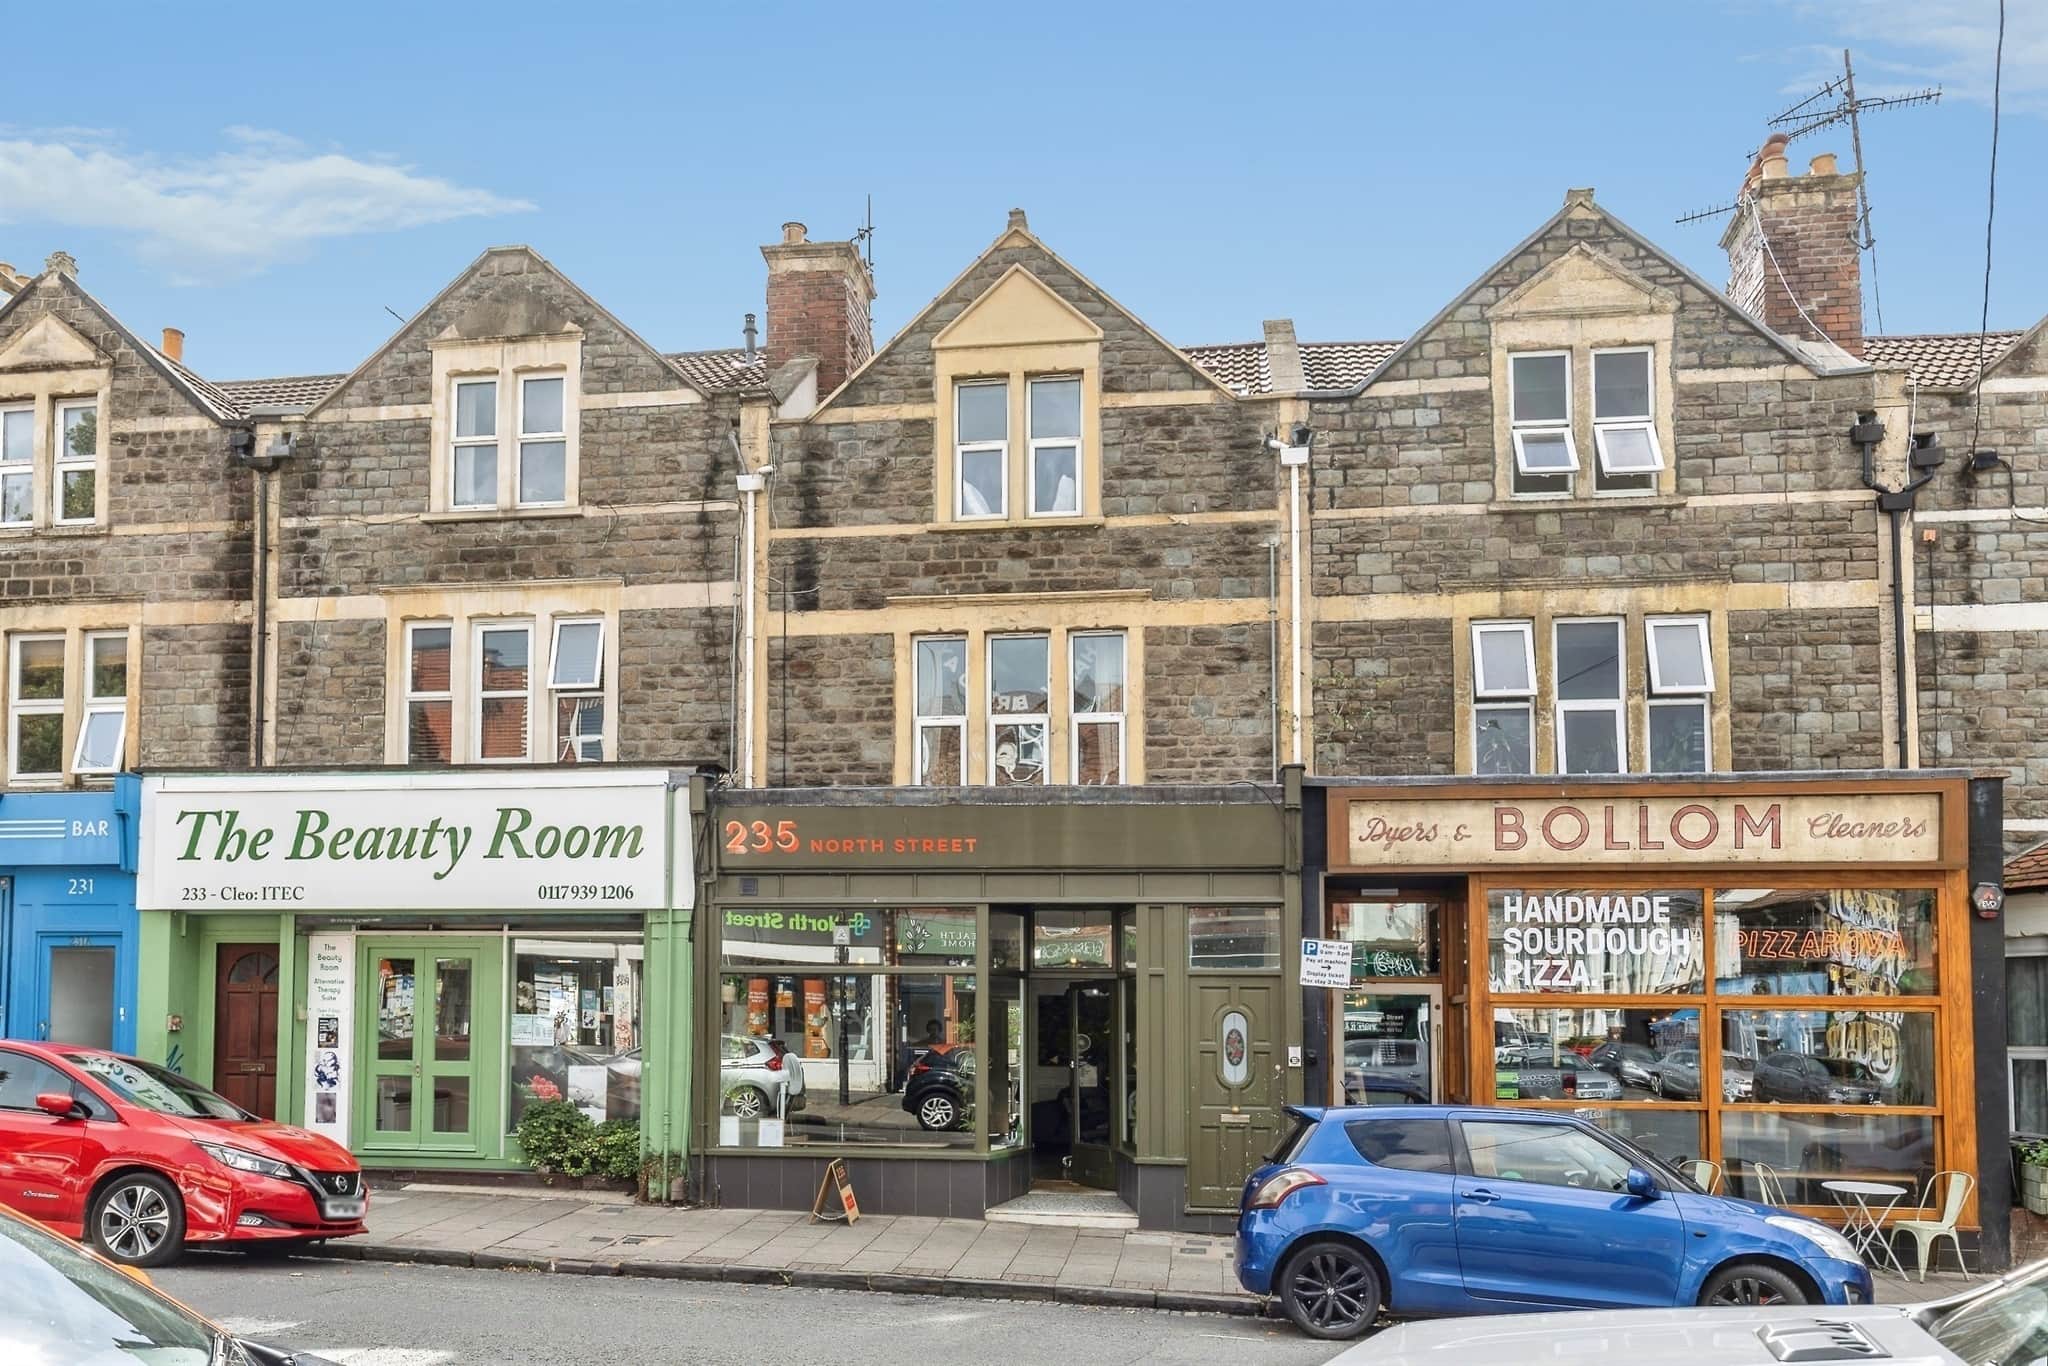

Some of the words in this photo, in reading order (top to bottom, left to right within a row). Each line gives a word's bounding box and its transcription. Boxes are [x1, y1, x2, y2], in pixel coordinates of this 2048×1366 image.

[72, 820, 109, 837] BAR
[1359, 817, 1438, 851] Dyers
[1454, 824, 1472, 842] &
[1494, 803, 1782, 851] BOLLOM
[1807, 813, 1926, 840] Cleaners
[175, 809, 274, 863] The
[284, 809, 472, 880] Beauty
[482, 807, 644, 859] Room
[726, 820, 800, 855] 235
[810, 839, 885, 853] NORTH
[894, 838, 977, 853] STREET
[68, 879, 94, 895] 231
[182, 887, 207, 901] 233
[220, 886, 259, 901] Cleo:
[262, 886, 305, 901] ITEC
[538, 885, 569, 900] 0117
[570, 885, 598, 900] 939
[600, 885, 634, 900] 1206
[1503, 896, 1671, 923] HANDMADE
[324, 943, 336, 951] The
[1306, 942, 1317, 954] P
[1503, 927, 1691, 955] SOURDOUGH
[1729, 929, 1906, 959] PIZZAROVA
[317, 953, 342, 963] Beauty
[319, 963, 339, 971] Room
[1306, 970, 1327, 978] Display
